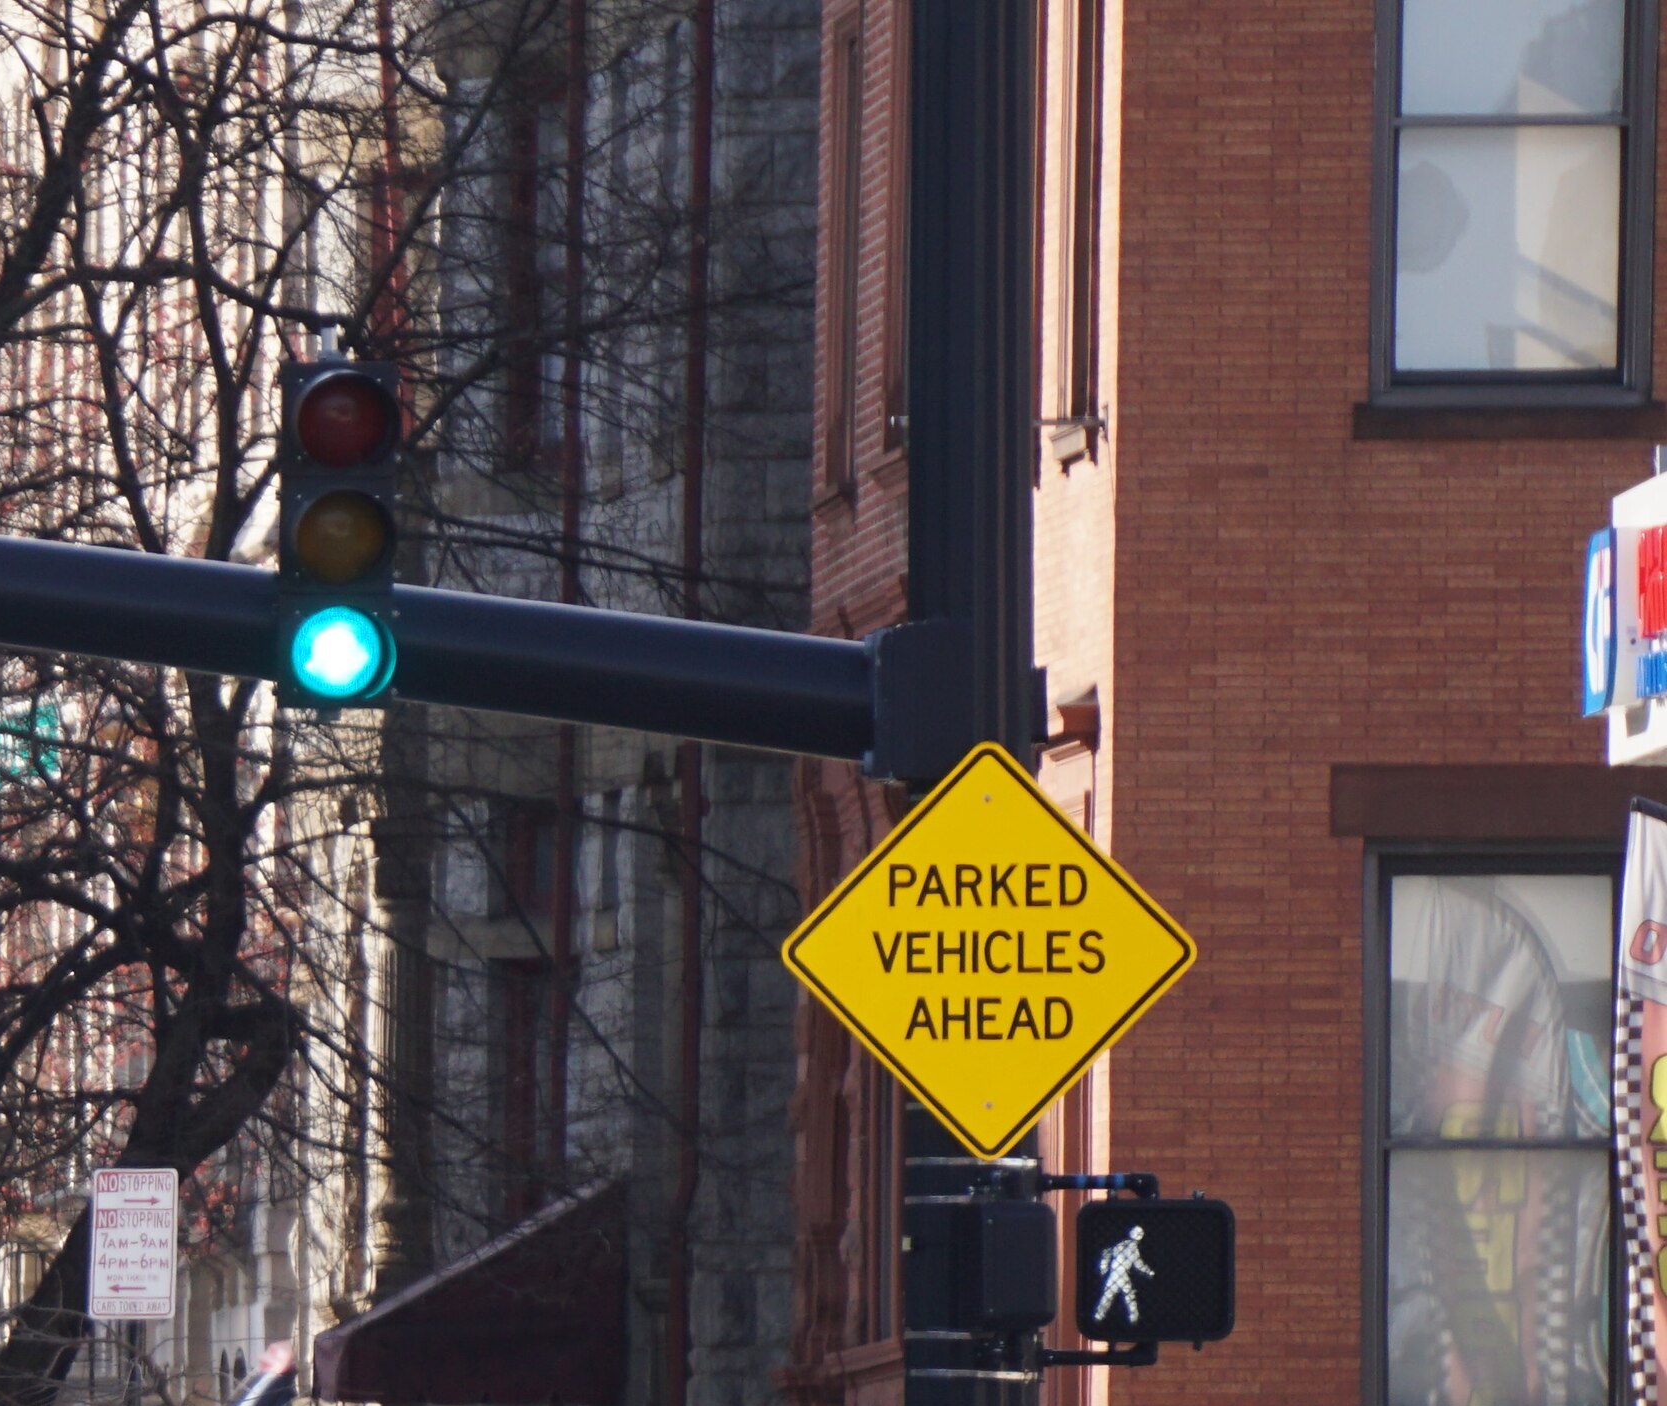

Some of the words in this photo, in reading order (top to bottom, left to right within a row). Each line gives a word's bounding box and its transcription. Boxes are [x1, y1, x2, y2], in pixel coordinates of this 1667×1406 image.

[888, 863, 1088, 907] PARKED
[872, 929, 1106, 974] VEHICLES
[904, 996, 1074, 1040] AHEAD
[98, 1174, 118, 1192] NO
[120, 1174, 172, 1192] STOPPING
[97, 1210, 117, 1228] NO
[119, 1210, 171, 1228] STOPPING
[100, 1233, 169, 1249] 7AM-9AM
[97, 1254, 170, 1269] 4PM-6PM
